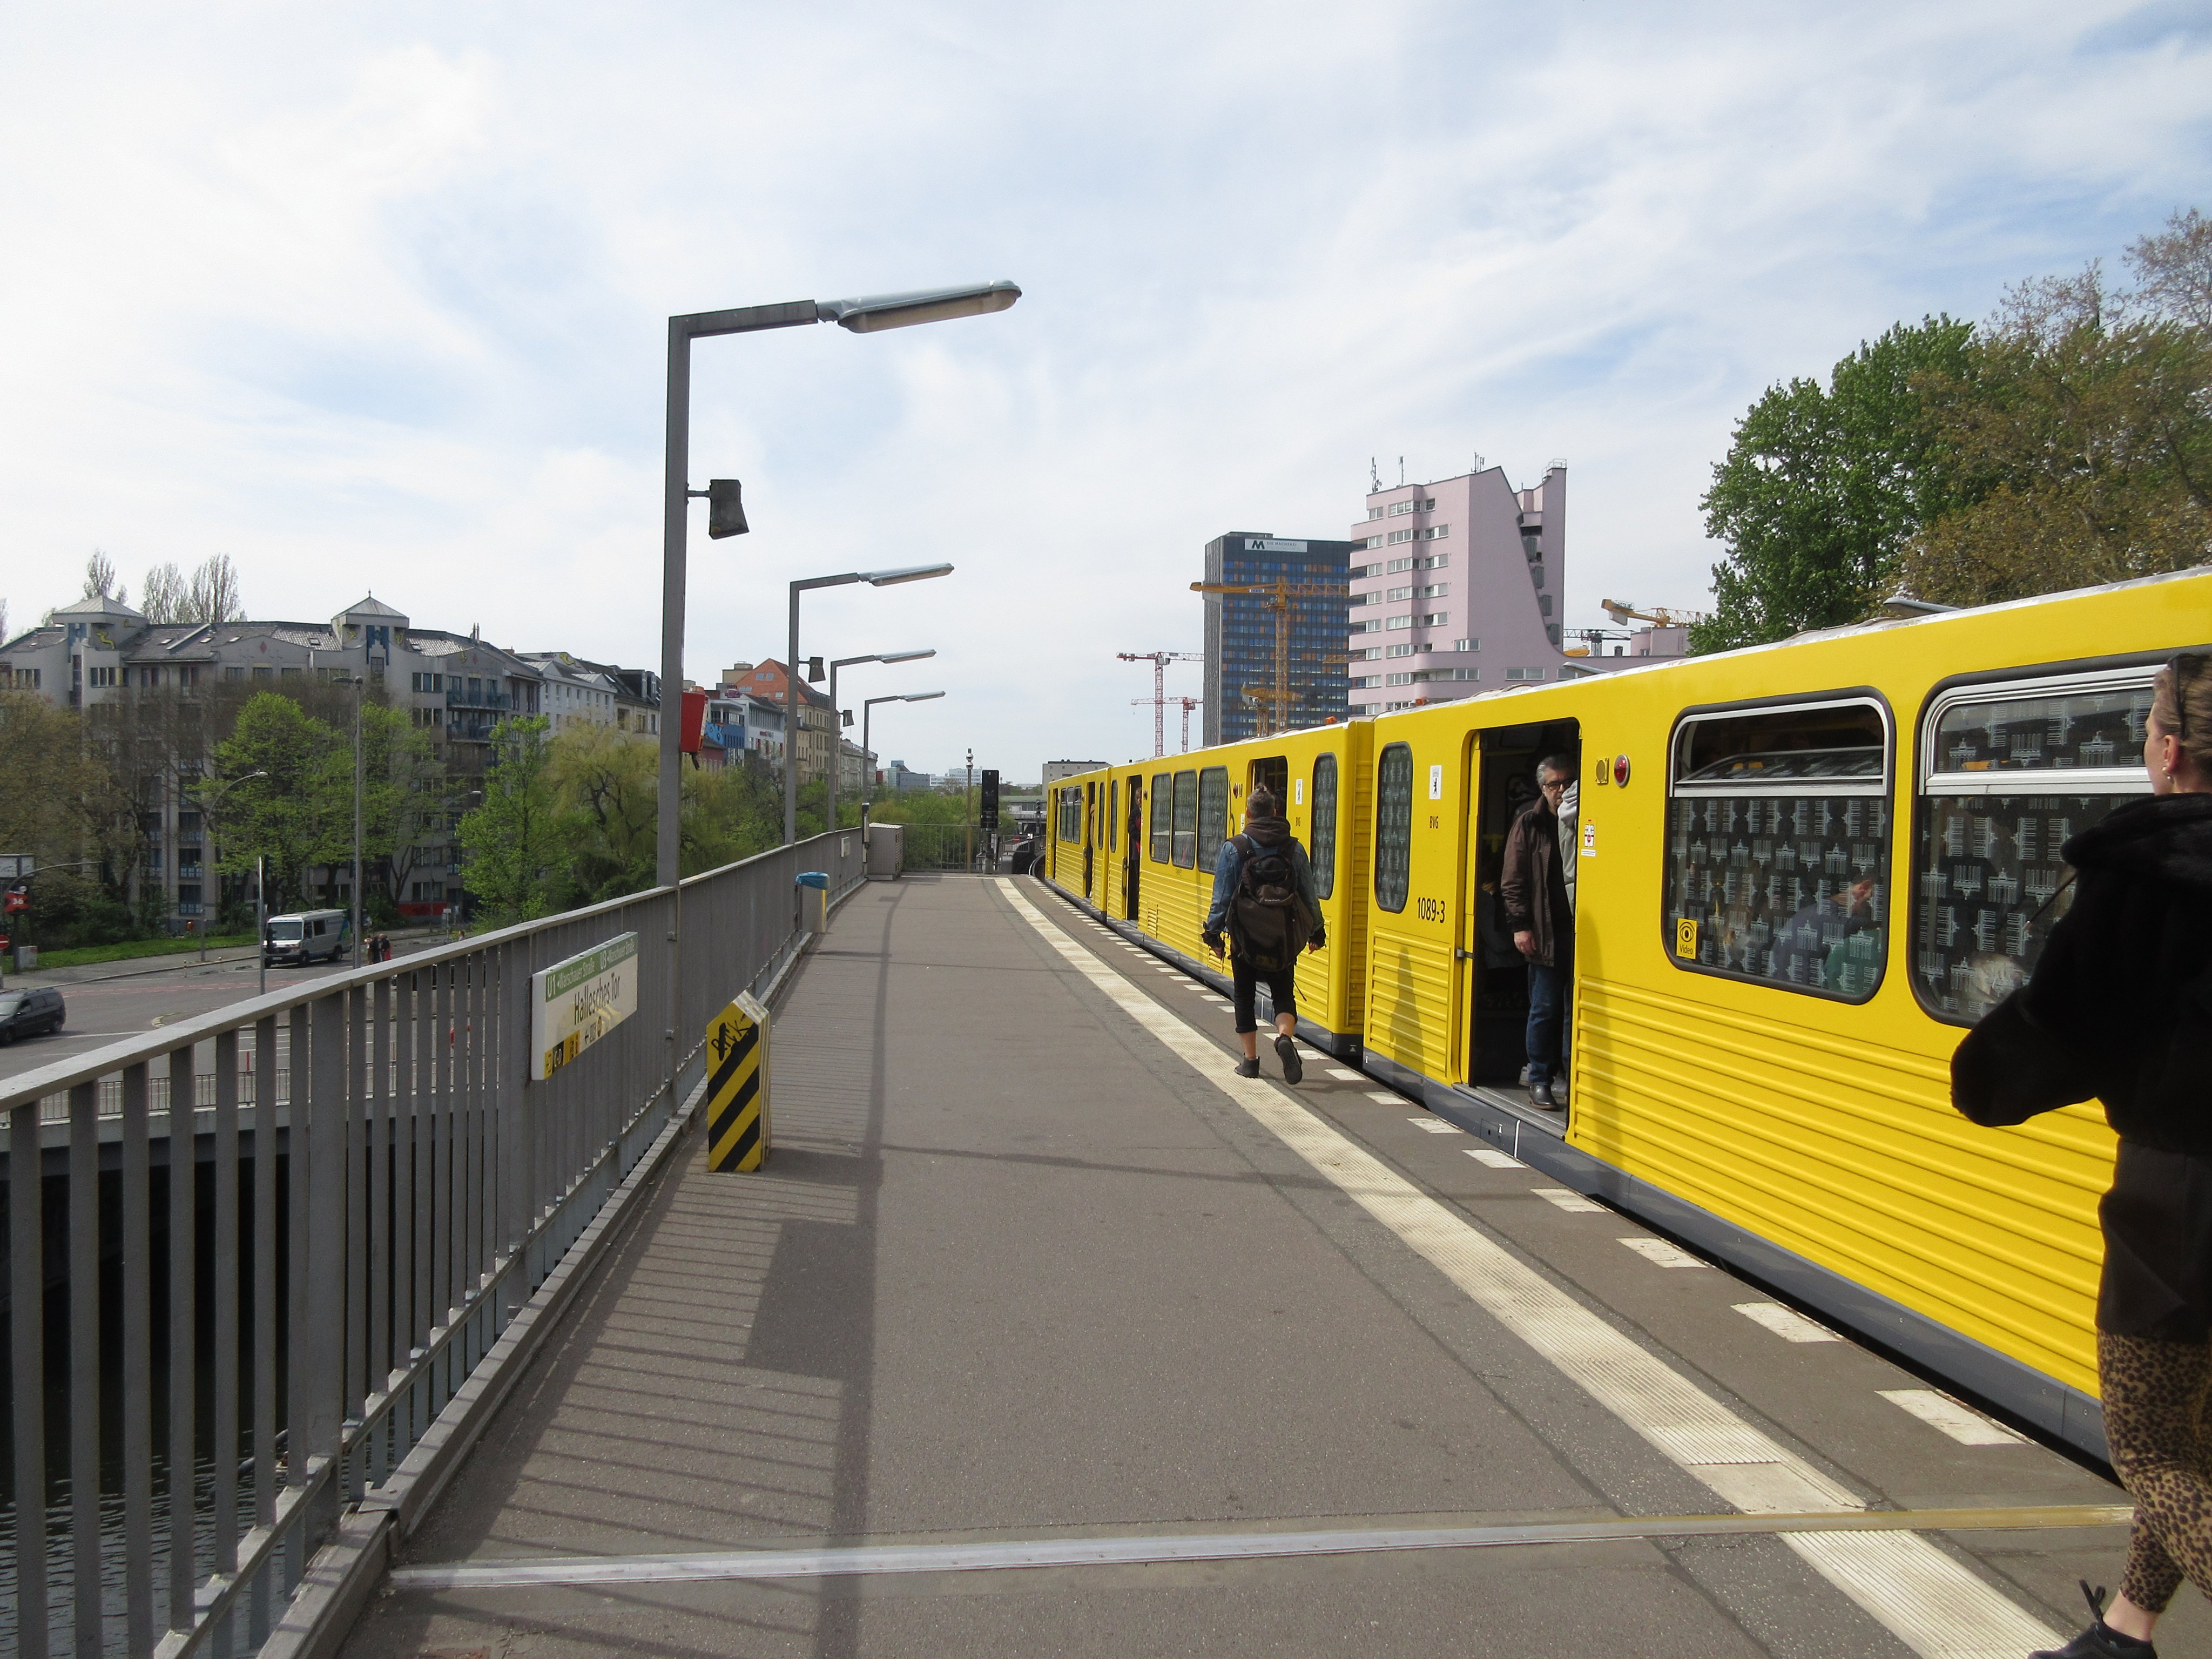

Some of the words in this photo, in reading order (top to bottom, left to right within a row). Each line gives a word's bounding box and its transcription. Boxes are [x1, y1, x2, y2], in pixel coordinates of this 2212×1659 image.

[1429, 815, 1439, 829] BVG
[1417, 896, 1445, 923] 1089-3
[600, 950, 607, 970] U3
[1680, 944, 1694, 955] Video
[547, 974, 556, 998] U1
[558, 966, 583, 989] Warschauer
[583, 957, 596, 977] Straße
[574, 977, 610, 1026] Hallesches
[611, 972, 621, 1001] Tor
